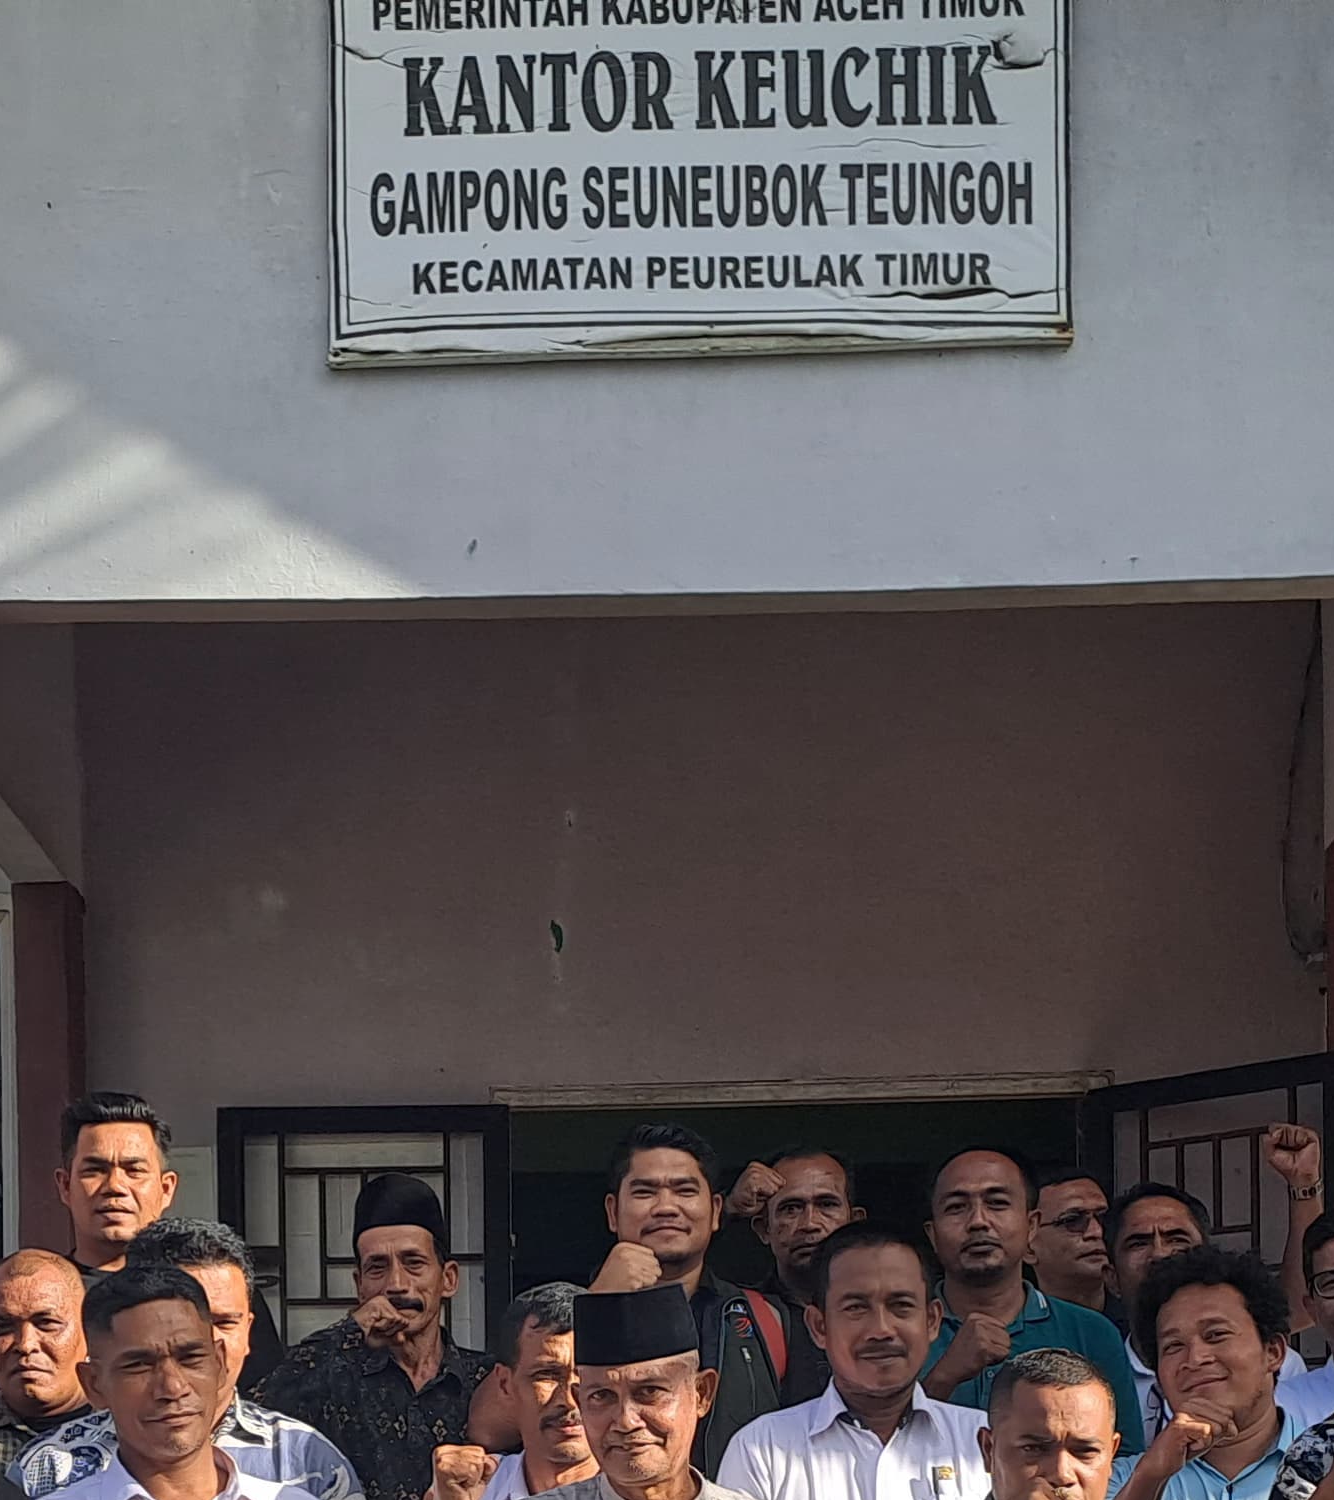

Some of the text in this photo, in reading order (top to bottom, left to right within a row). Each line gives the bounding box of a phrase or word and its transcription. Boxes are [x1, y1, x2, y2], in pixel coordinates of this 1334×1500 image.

[372, 0, 588, 31] PEMERINTAH
[601, 0, 802, 27] KABUPATEN
[813, 0, 904, 22] ACEH
[403, 44, 998, 136] KANTOR KEUCHIK
[370, 160, 1034, 237] GAMPONG SEUNEUBOK TEUNGOH
[412, 252, 992, 295] KECAMATAN PEUREULAK TIMUR
